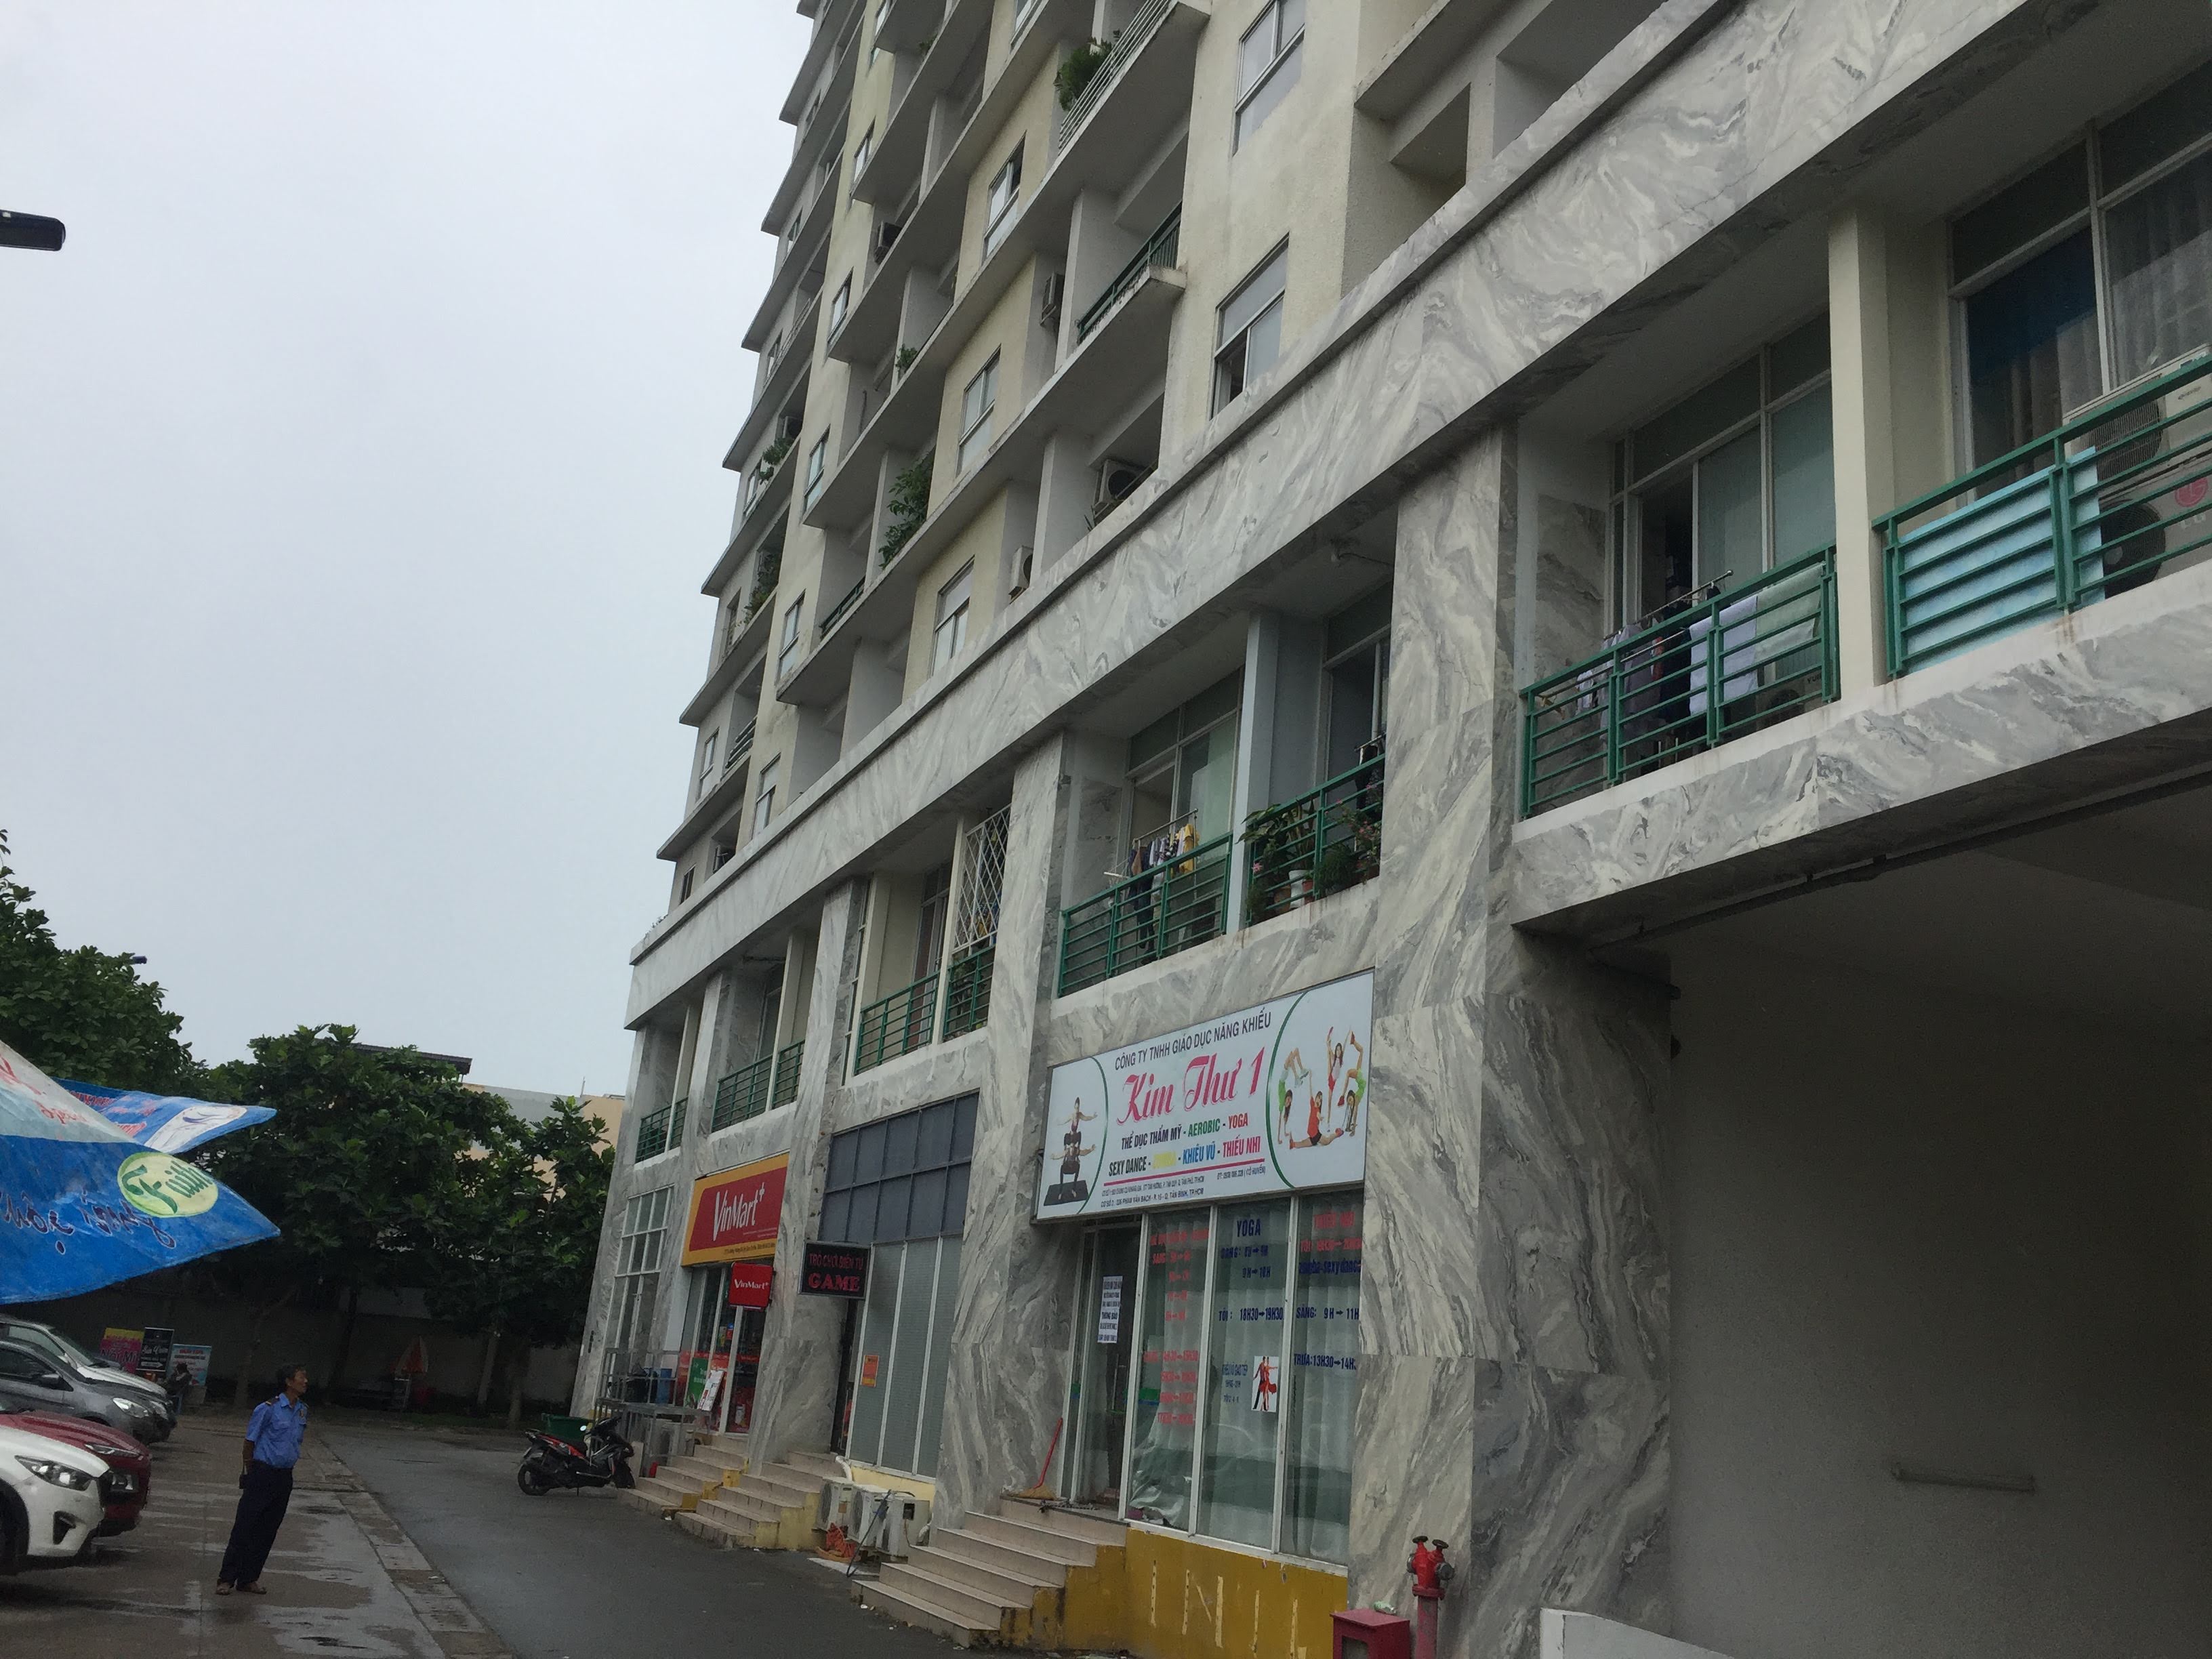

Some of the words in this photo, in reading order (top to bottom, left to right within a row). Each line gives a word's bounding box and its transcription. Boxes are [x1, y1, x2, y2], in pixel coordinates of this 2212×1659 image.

[1115, 1052, 1136, 1071] CÔNG
[1138, 1048, 1148, 1063] TY
[1149, 1042, 1170, 1061] TNHH
[1172, 1033, 1193, 1054] GIÁO
[1193, 1029, 1212, 1049] DỤC
[1214, 1021, 1240, 1042] NĂNG
[1242, 1007, 1271, 1034] KHIẾU
[1117, 1071, 1175, 1125] Kim
[1183, 1052, 1243, 1112] Thư
[1248, 1046, 1265, 1096] 1
[1134, 1132, 1148, 1150] DỤC
[1170, 1124, 1183, 1141] MỸ
[1187, 1118, 1221, 1138] AEROBIC
[1228, 1112, 1248, 1130] YOGA
[1108, 1161, 1124, 1177] SEXY
[1126, 1155, 1147, 1174] DANCE
[1223, 1132, 1244, 1158] THIẾU
[1246, 1135, 1261, 1155] NHI
[1236, 1218, 1261, 1237] YOGA
[808, 1271, 861, 1292] GAME
[1240, 1307, 1259, 1322] 18H30
[1265, 1307, 1284, 1321] 19H30
[1324, 1307, 1334, 1319] 9H
[1346, 1307, 1359, 1321] 11H
